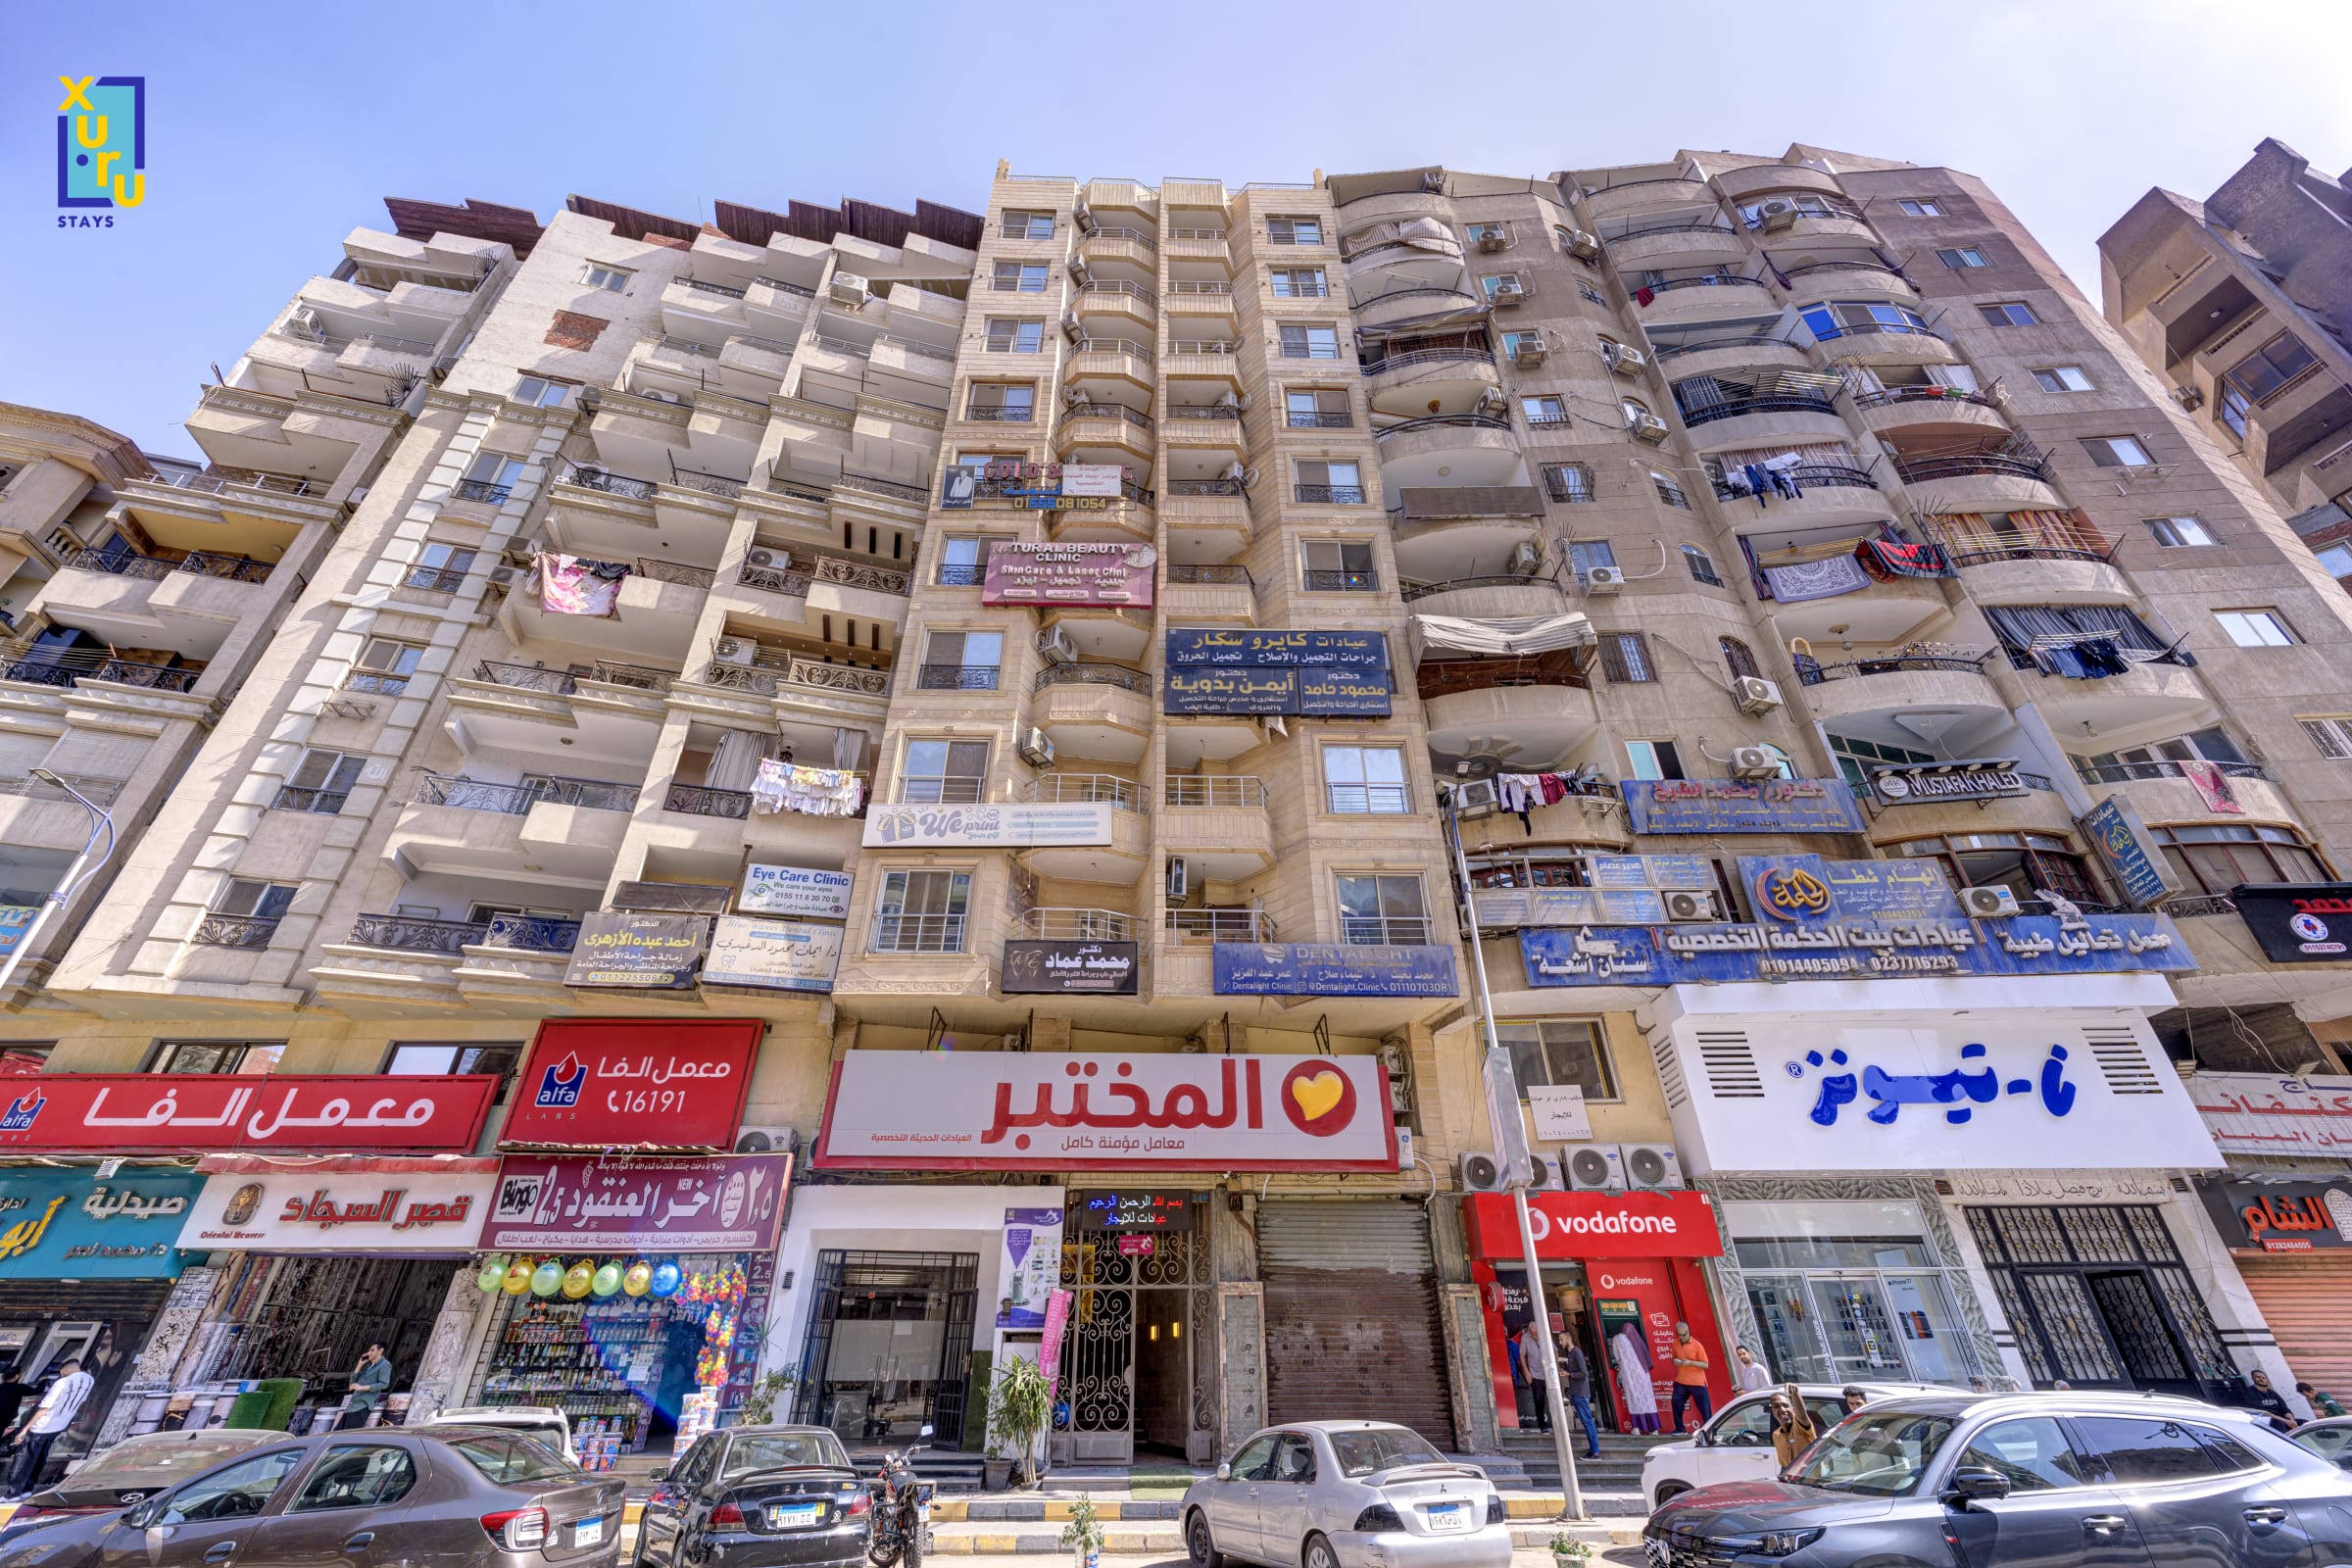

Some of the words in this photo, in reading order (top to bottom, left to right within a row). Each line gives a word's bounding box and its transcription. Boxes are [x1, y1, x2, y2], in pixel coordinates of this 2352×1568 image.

[1013, 496, 1107, 510] 01555081054
[1066, 543, 1129, 554] BEAUTY
[1035, 554, 1082, 563] CLINIC
[1192, 632, 1243, 648] سكار
[1250, 633, 1307, 651] كايرو
[1316, 635, 1368, 647] عيادات
[1177, 651, 1209, 662] الحروق
[1211, 652, 1243, 662] تجميل
[1301, 653, 1338, 664] التجميل
[1340, 654, 1377, 664] جراحات
[1215, 669, 1248, 678] دكتور
[1327, 672, 1360, 681] دكتور
[1170, 675, 1234, 693] بدوية
[1239, 672, 1295, 696] أيمن
[1303, 684, 1336, 696] حامد
[1339, 684, 1387, 697] محمود
[1958, 770, 2023, 793] KHALED
[1709, 784, 1759, 800] محمد
[919, 810, 965, 837] We
[963, 820, 1001, 837] print
[753, 867, 774, 881] Eye
[780, 870, 808, 882] Care
[814, 874, 849, 886] Clinic
[584, 929, 632, 948] الأزهرى
[633, 935, 662, 950] عبده
[664, 931, 698, 948] أحمد
[1667, 925, 1768, 960] التخصصية
[1770, 925, 1848, 950] الحكمة
[1997, 931, 2055, 958] طبية
[2058, 929, 2123, 956] تحاليل
[2128, 928, 2172, 954] معمل
[1077, 945, 1102, 955] دكتور
[1297, 948, 1412, 960] DENTALIGHT
[627, 953, 657, 962] جراحة
[1046, 952, 1082, 968] عماد
[1085, 955, 1131, 969] محمد
[1277, 970, 1292, 980] عمر
[1318, 969, 1339, 981] صلاح
[1233, 982, 1270, 992] Dentalight
[597, 1055, 654, 1078] الفا
[652, 1055, 731, 1085] معمل
[540, 1086, 576, 1103] alfa
[624, 1090, 686, 1113] 16191
[83, 1087, 254, 1127] الفا
[981, 1058, 1263, 1151] المختبر
[2, 1113, 32, 1127] alfa
[247, 1088, 435, 1140] معمل
[871, 1133, 908, 1144] التخصصية
[909, 1133, 941, 1143] الحديثة
[942, 1133, 972, 1143] العيادات
[1061, 1136, 1095, 1151] كامل
[1099, 1136, 1140, 1152] مؤمنة
[1143, 1137, 1185, 1151] معامل
[677, 1178, 694, 1191] NEW
[1960, 1179, 1982, 1197] الله
[2050, 1179, 2087, 1200] فيصل
[2086, 1184, 2103, 1198] برج
[82, 1187, 188, 1219] صيدلية
[501, 1178, 539, 1215] Bingo
[564, 1177, 662, 1229] العنقود
[654, 1174, 727, 1229] آخر
[1089, 1195, 1116, 1210] الرحيم
[1119, 1195, 1151, 1208] الرحمن
[1152, 1195, 1164, 1206] الله
[279, 1189, 408, 1229] السجاد
[1166, 1199, 1183, 1210] بسم
[392, 1195, 474, 1230] قصر
[1103, 1211, 1135, 1225] للايجار
[1137, 1212, 1167, 1225] عيادات
[2244, 1195, 2334, 1243] الشام
[1556, 1211, 1677, 1234] vodafone
[200, 1231, 232, 1240] Oriental
[595, 1235, 622, 1245] مدرسية
[624, 1233, 644, 1244] أدوات
[651, 1234, 671, 1245] منزلية
[672, 1233, 693, 1244] أدوات
[722, 1233, 754, 1244] إكسسوار
[99, 1245, 146, 1257] محمد
[1616, 1277, 1653, 1286] vodafone
[749, 1285, 769, 1295] Bingo
